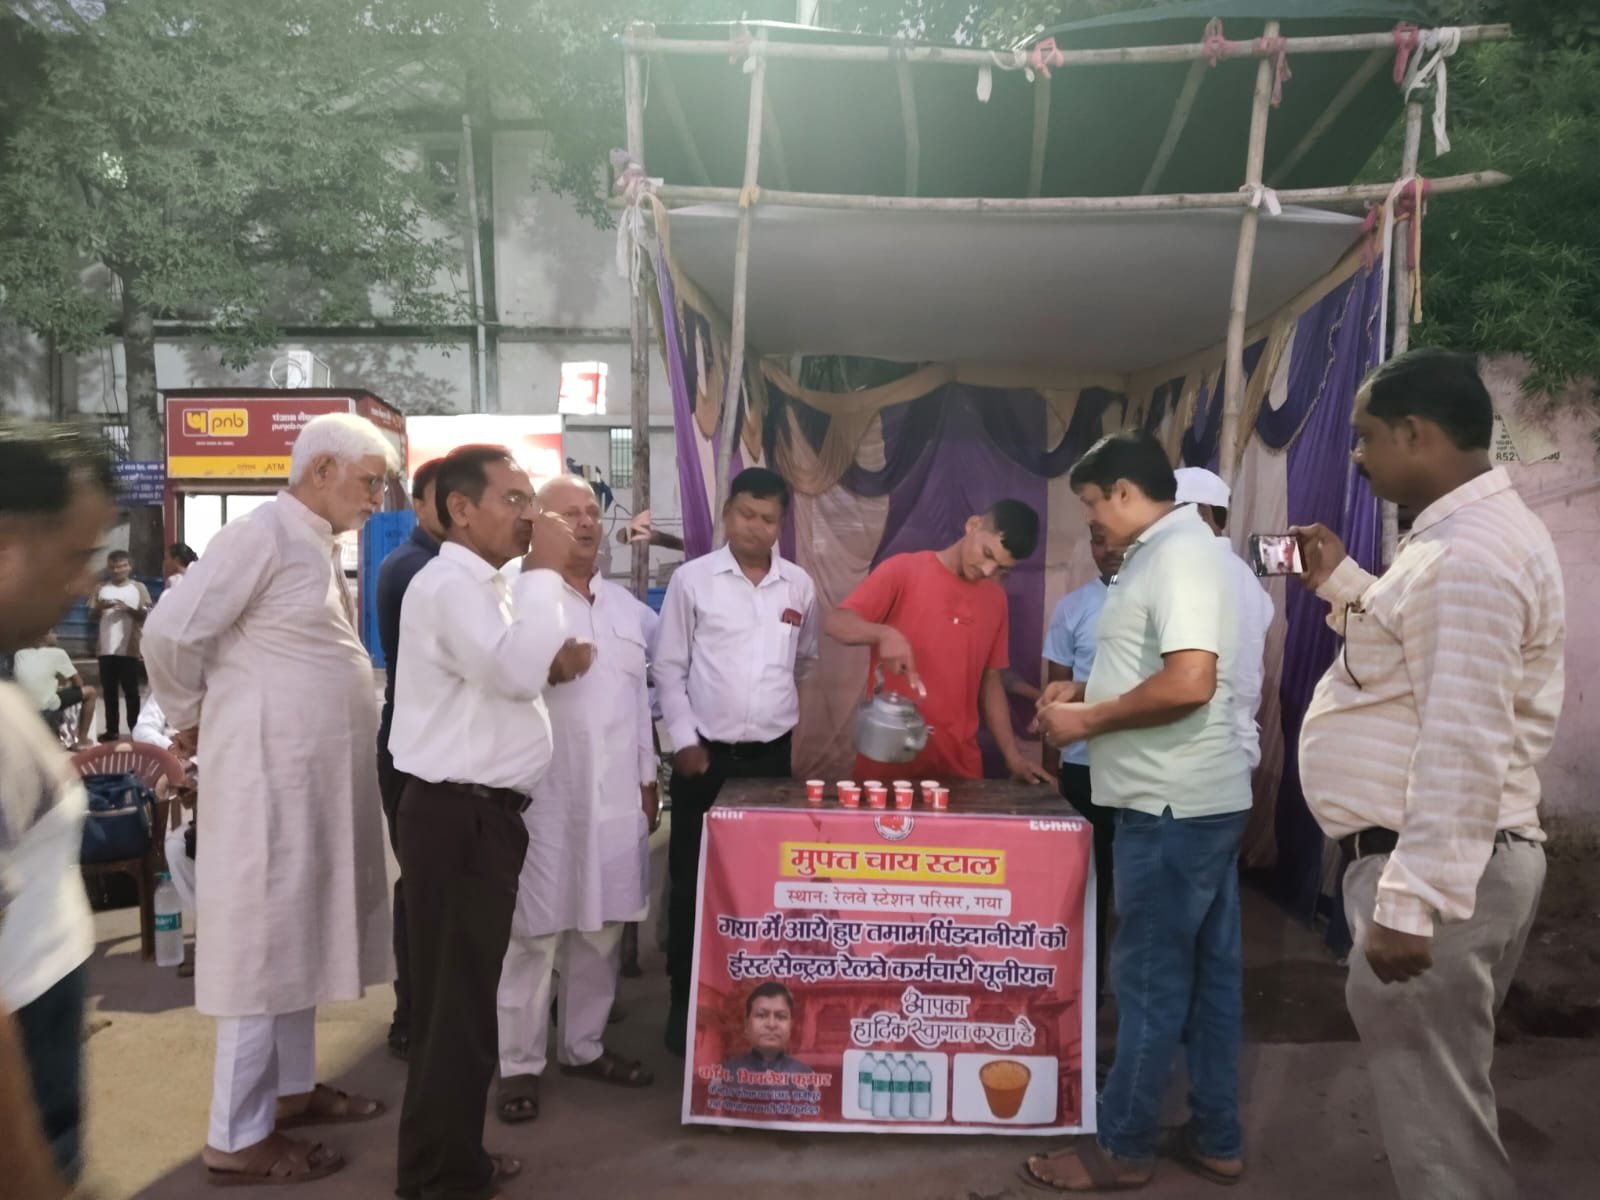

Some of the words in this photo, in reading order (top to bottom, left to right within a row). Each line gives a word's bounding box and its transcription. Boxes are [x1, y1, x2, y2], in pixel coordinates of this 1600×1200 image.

[212, 412, 244, 433] pnb
[265, 463, 286, 474] ATM
[864, 851, 920, 873] चाय
[926, 853, 1001, 876] स्टाल
[787, 888, 828, 905] स्थान:
[834, 886, 867, 906] रेलवे
[872, 887, 914, 907] स्टेशन
[974, 896, 1003, 910] गया
[718, 915, 757, 939] गया
[761, 914, 783, 939] में
[785, 915, 828, 940] आये
[832, 922, 862, 947] हुए
[866, 922, 926, 944] तमाम
[1039, 925, 1068, 949] को
[728, 951, 770, 979] ईस्ट
[773, 952, 837, 982] सेन्ट्रल
[838, 953, 889, 979] रेलवे
[892, 954, 975, 982] कर्मचारी
[978, 958, 1055, 991] यूनीयन
[903, 989, 970, 1016] आपका
[852, 1013, 907, 1044] हार्दिक
[909, 1016, 970, 1047] स्वागत
[971, 1023, 1017, 1049] करता
[1014, 1017, 1035, 1044] है
